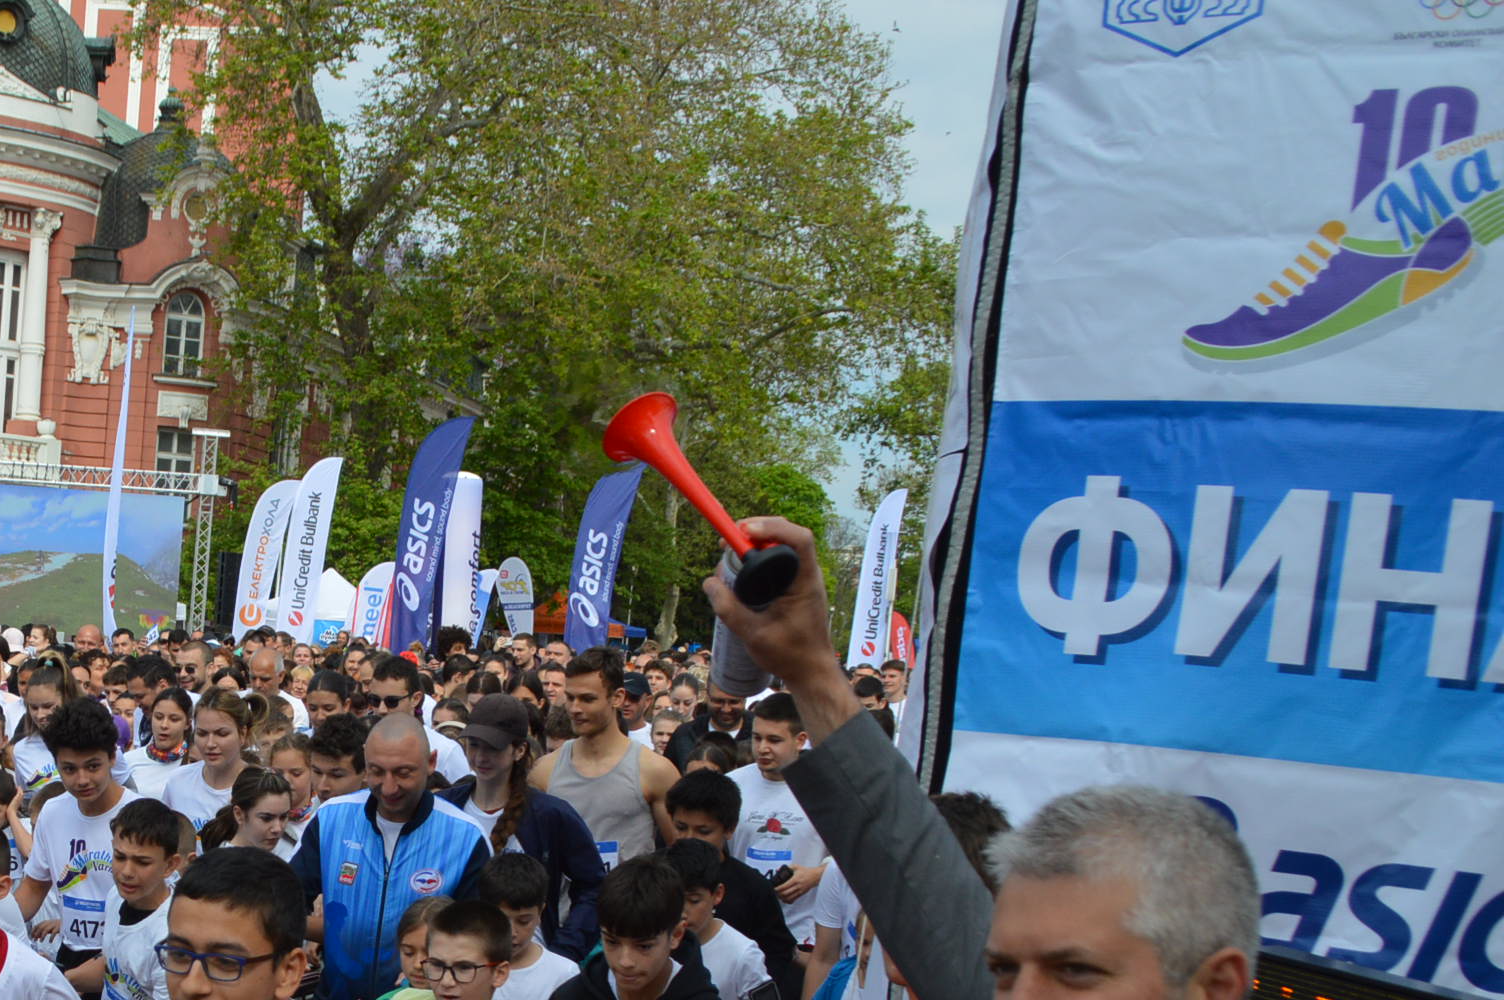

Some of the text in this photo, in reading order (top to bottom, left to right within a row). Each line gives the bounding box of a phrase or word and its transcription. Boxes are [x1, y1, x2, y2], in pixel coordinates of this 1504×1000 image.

[291, 491, 323, 609] UniCredit Bulbank
[864, 523, 890, 640] UniCredit Bulbank
[1017, 475, 1504, 692] ФИН
[73, 848, 112, 871] Marath
[93, 860, 113, 873] Varn
